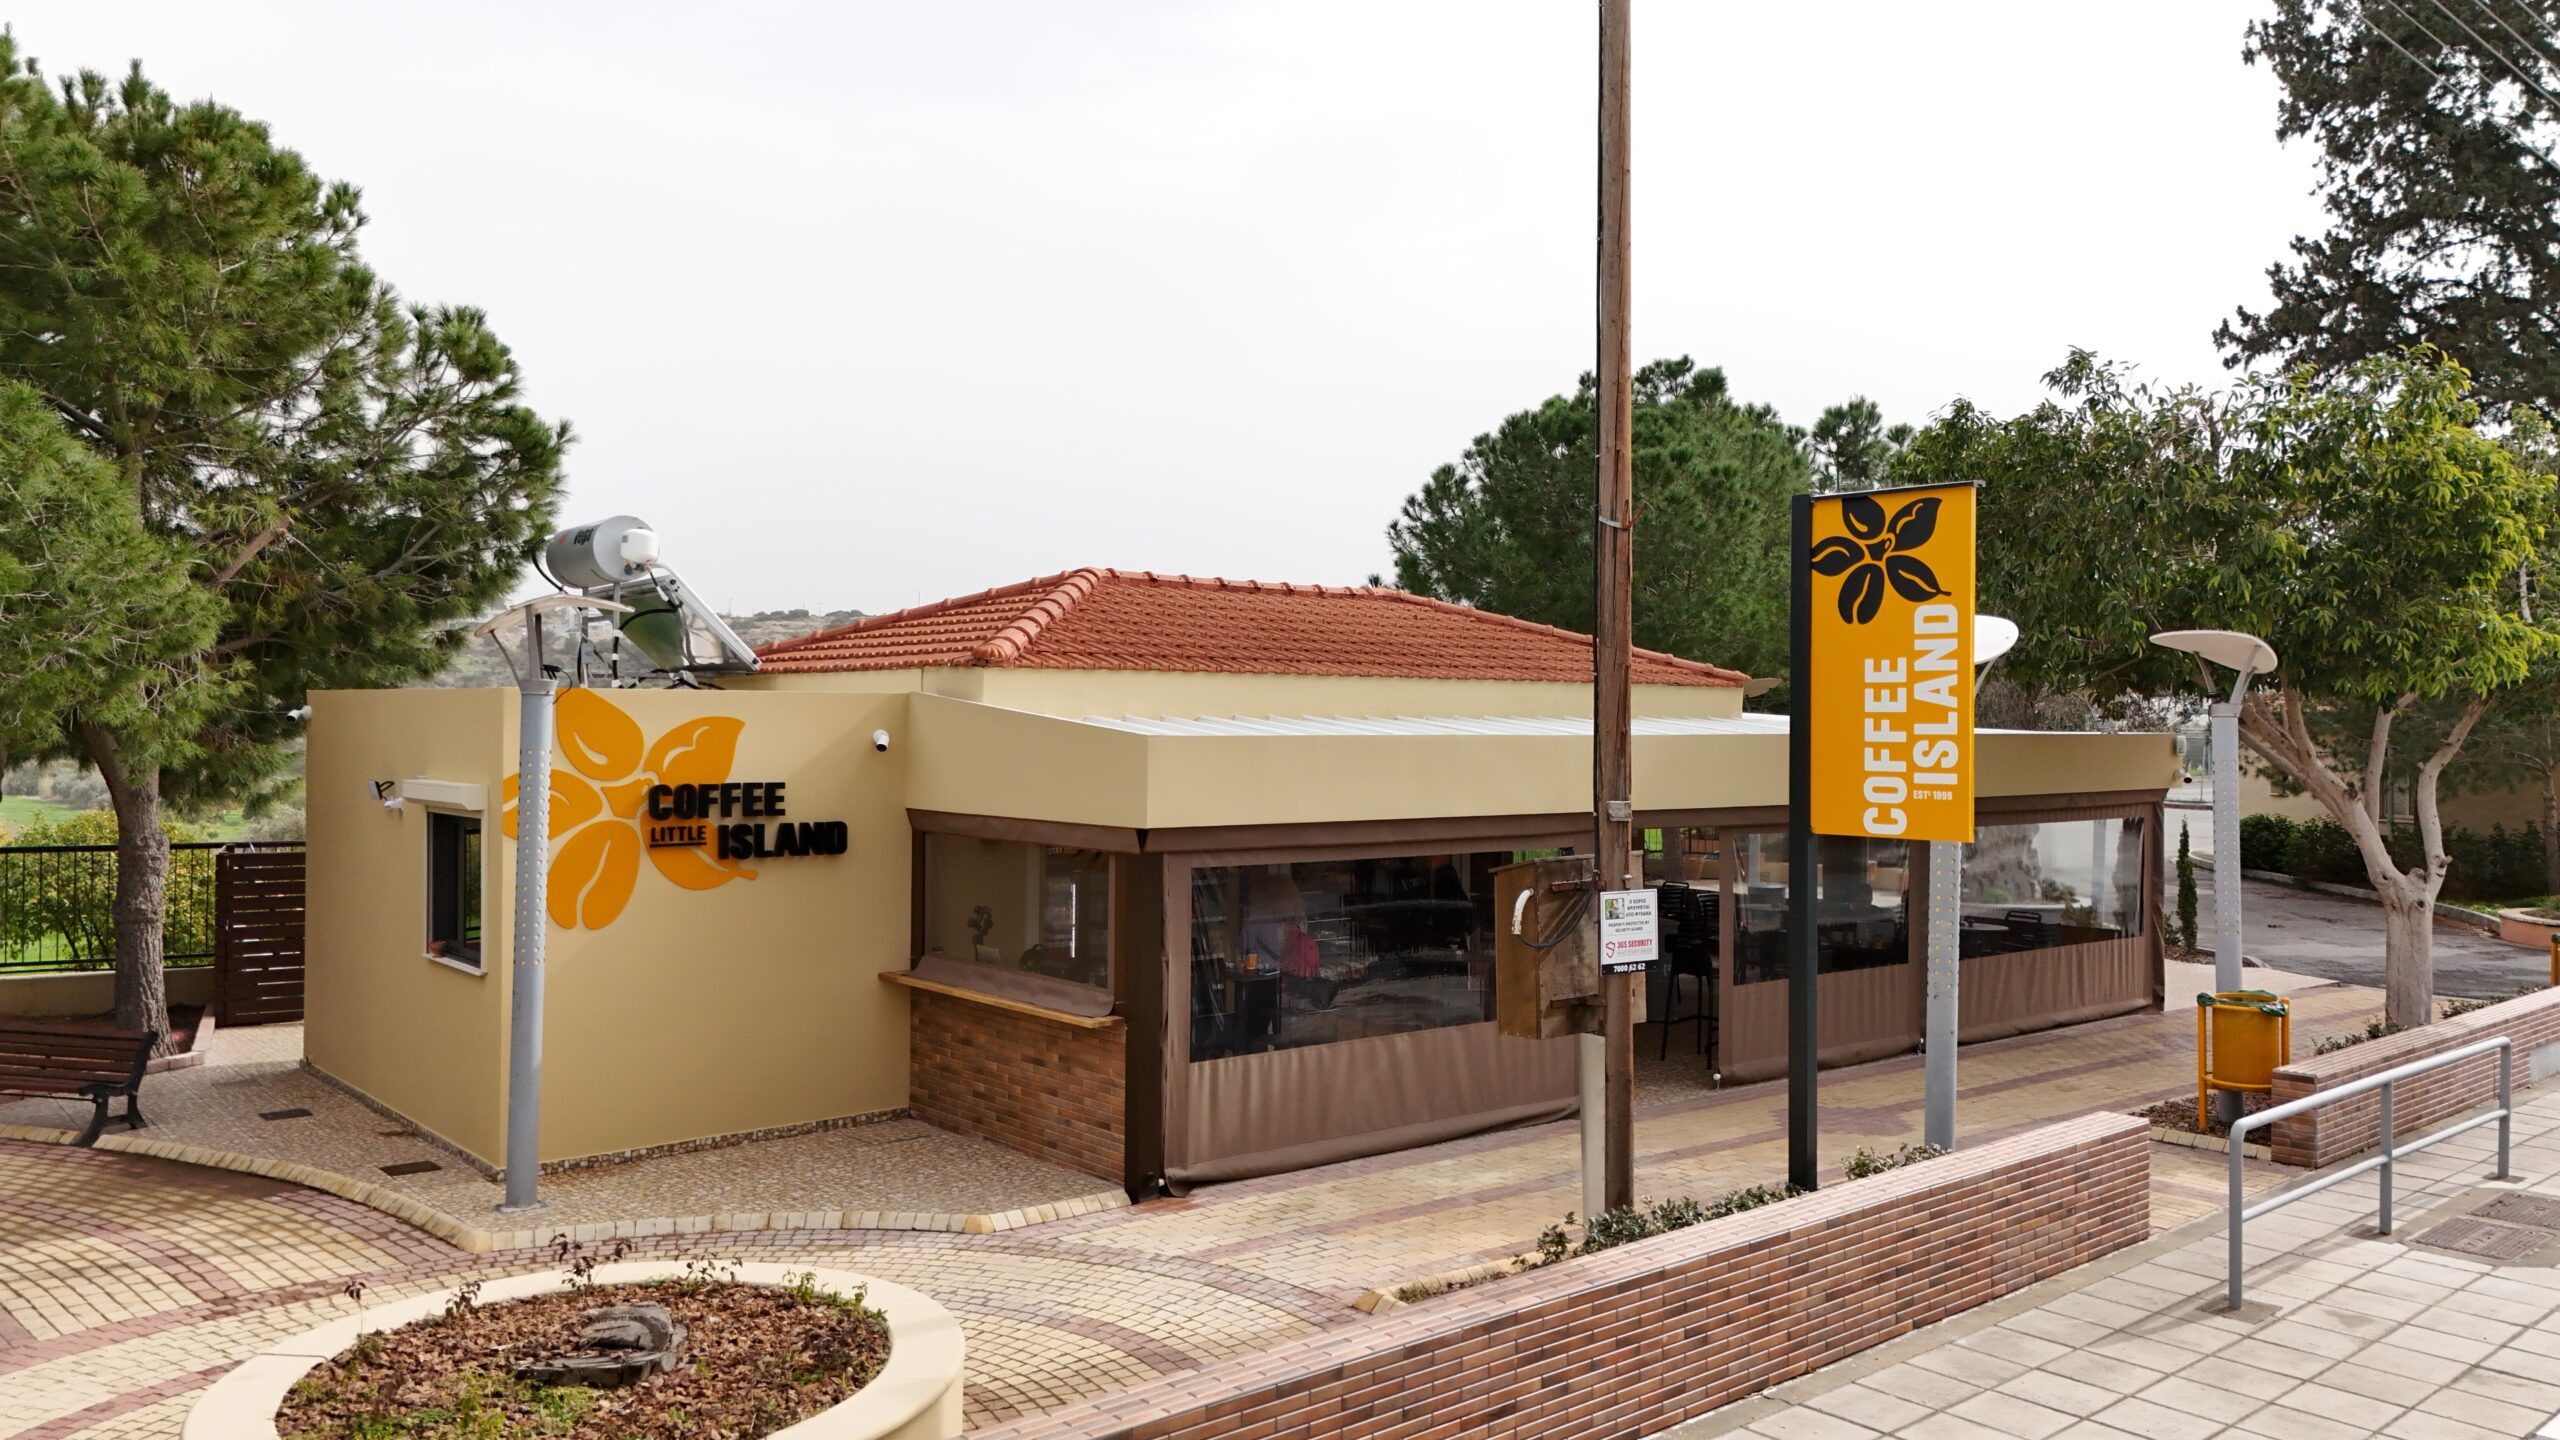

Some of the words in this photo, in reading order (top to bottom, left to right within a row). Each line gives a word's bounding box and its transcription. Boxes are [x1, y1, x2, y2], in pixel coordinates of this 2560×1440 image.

[1912, 604, 1959, 785] ISLAND
[1862, 656, 1908, 836] COFFEE
[648, 782, 786, 821] COFFEE
[1932, 791, 1953, 801] 1999
[650, 826, 707, 843] LITTLE
[717, 821, 848, 860] ISLAND
[1628, 939, 1652, 948] SECURITY
[1614, 964, 1628, 974] 7000
[1638, 962, 1646, 970] 62
